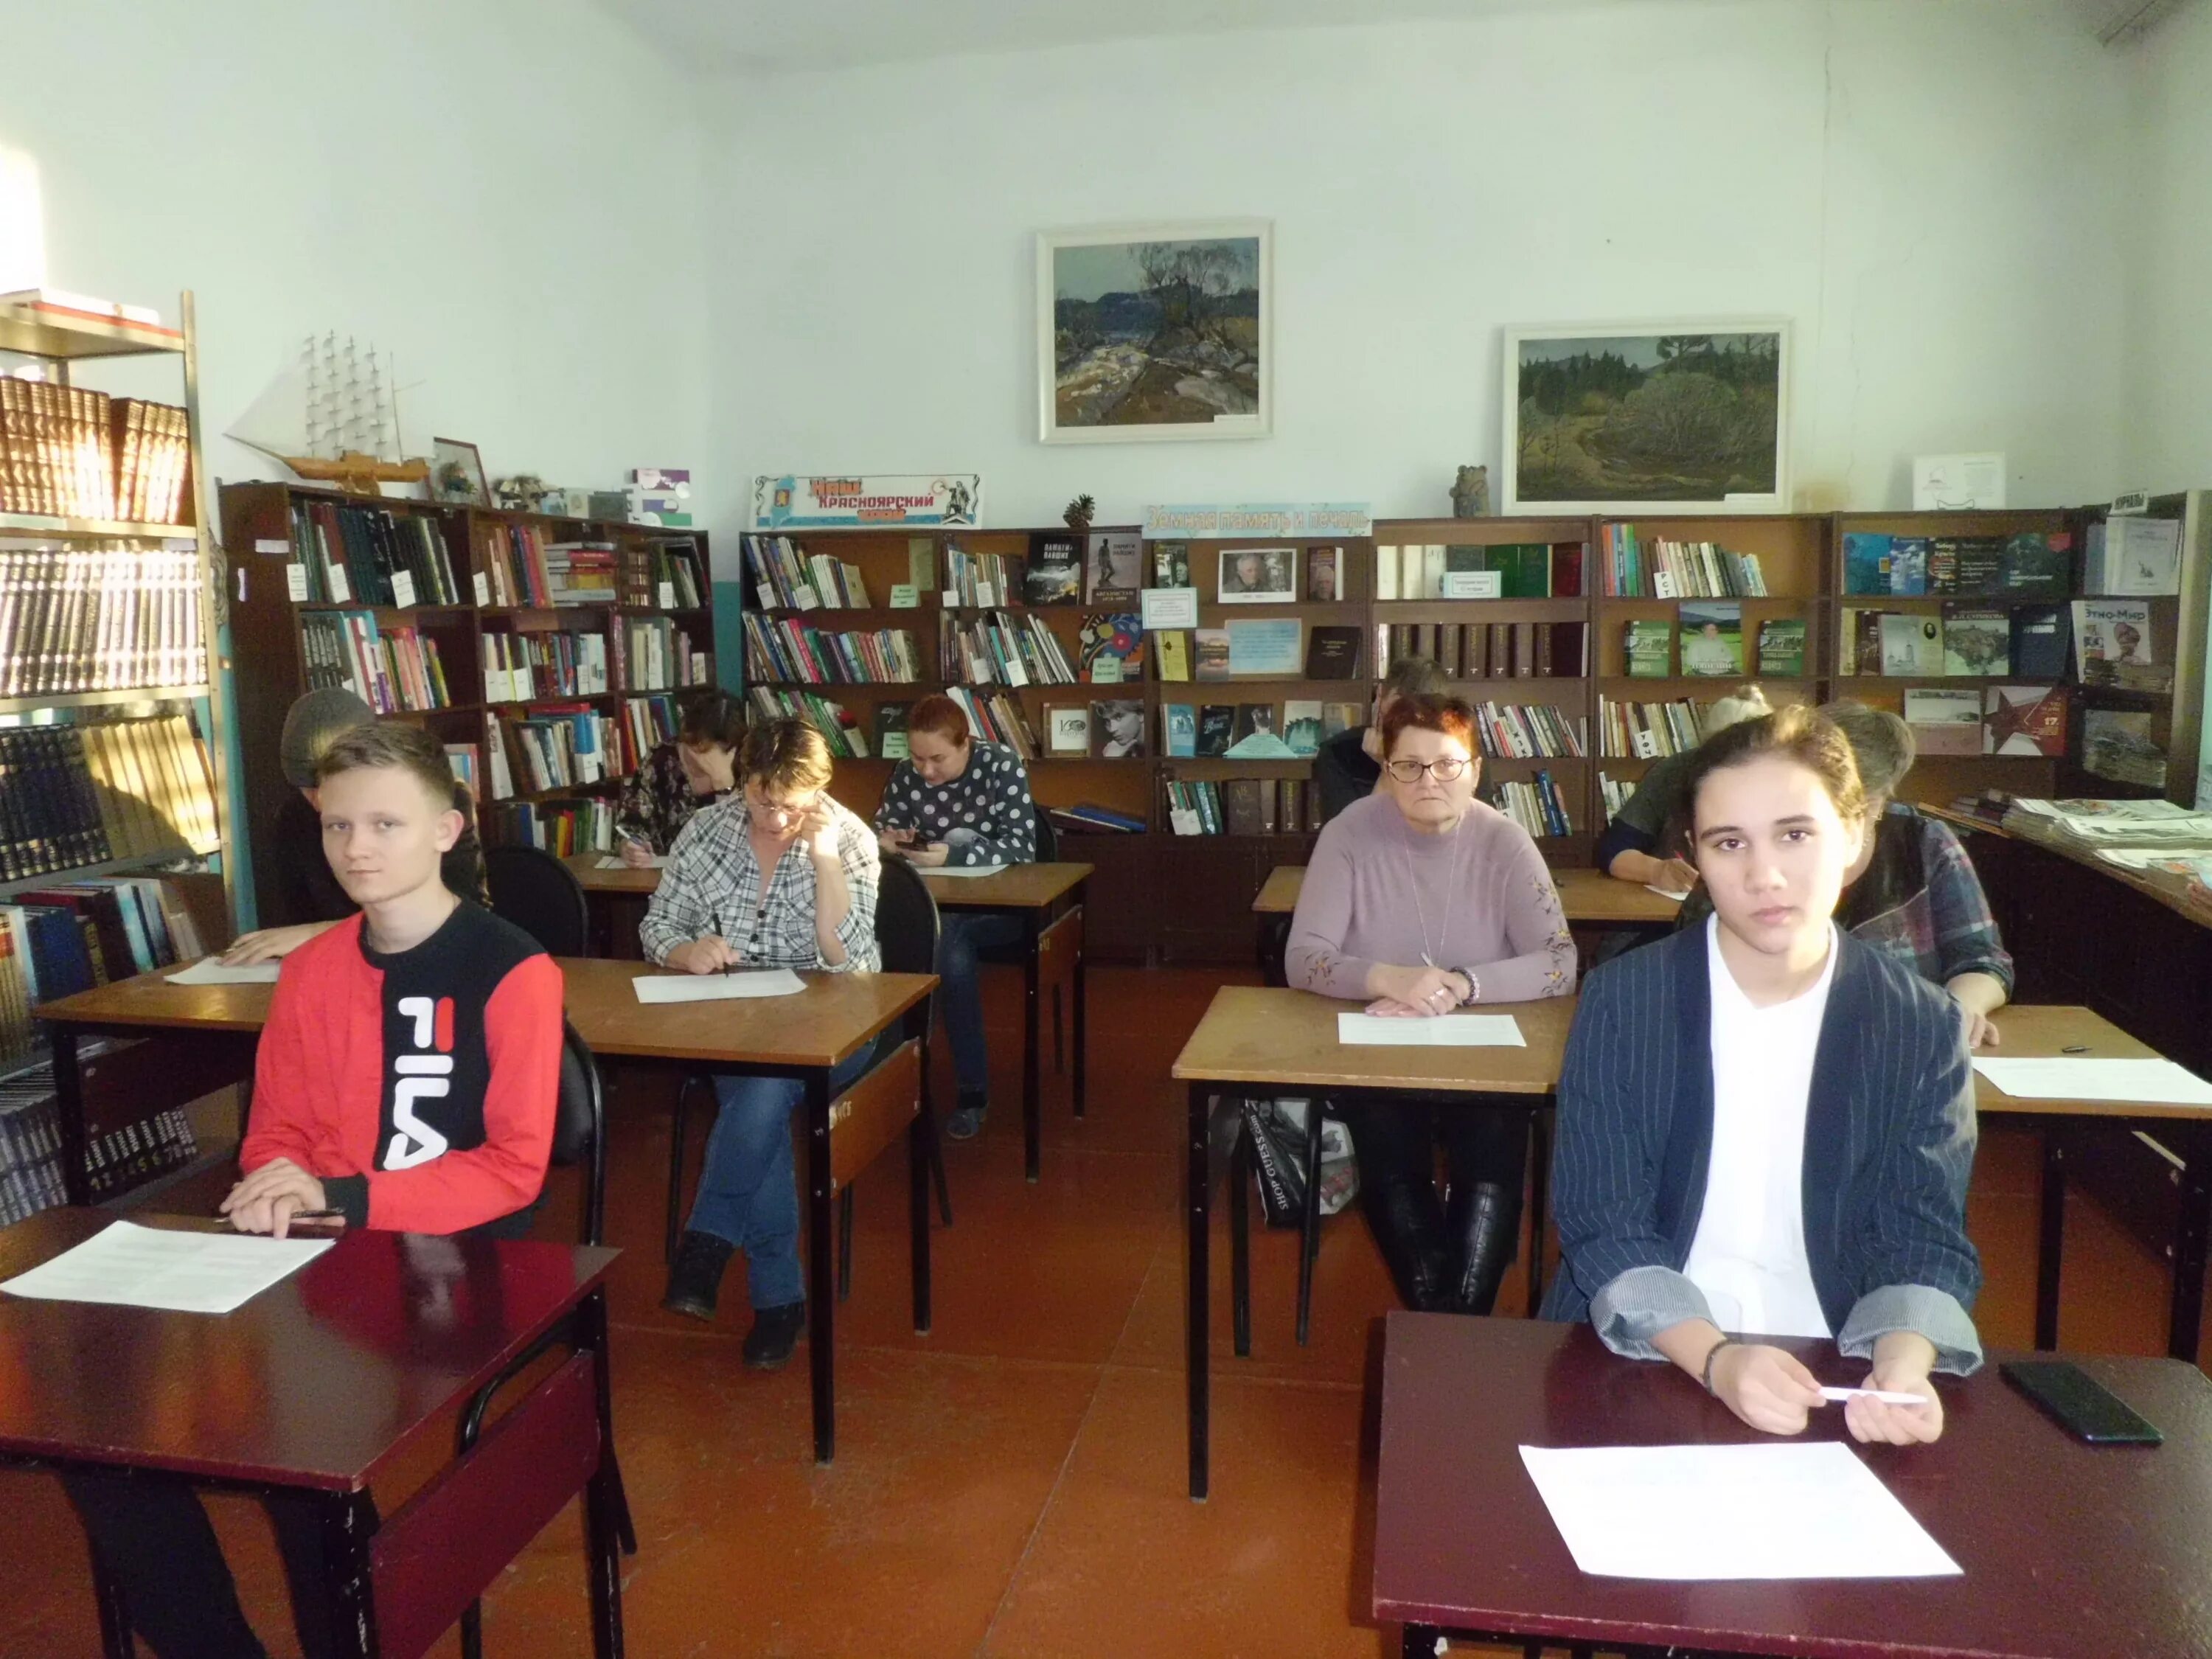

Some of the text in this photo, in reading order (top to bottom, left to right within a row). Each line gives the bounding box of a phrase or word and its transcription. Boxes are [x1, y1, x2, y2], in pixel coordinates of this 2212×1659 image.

[1147, 504, 1369, 531] Земная память и печаль
[383, 997, 455, 1171] FILA
[1270, 1180, 1290, 1211] SHOP
